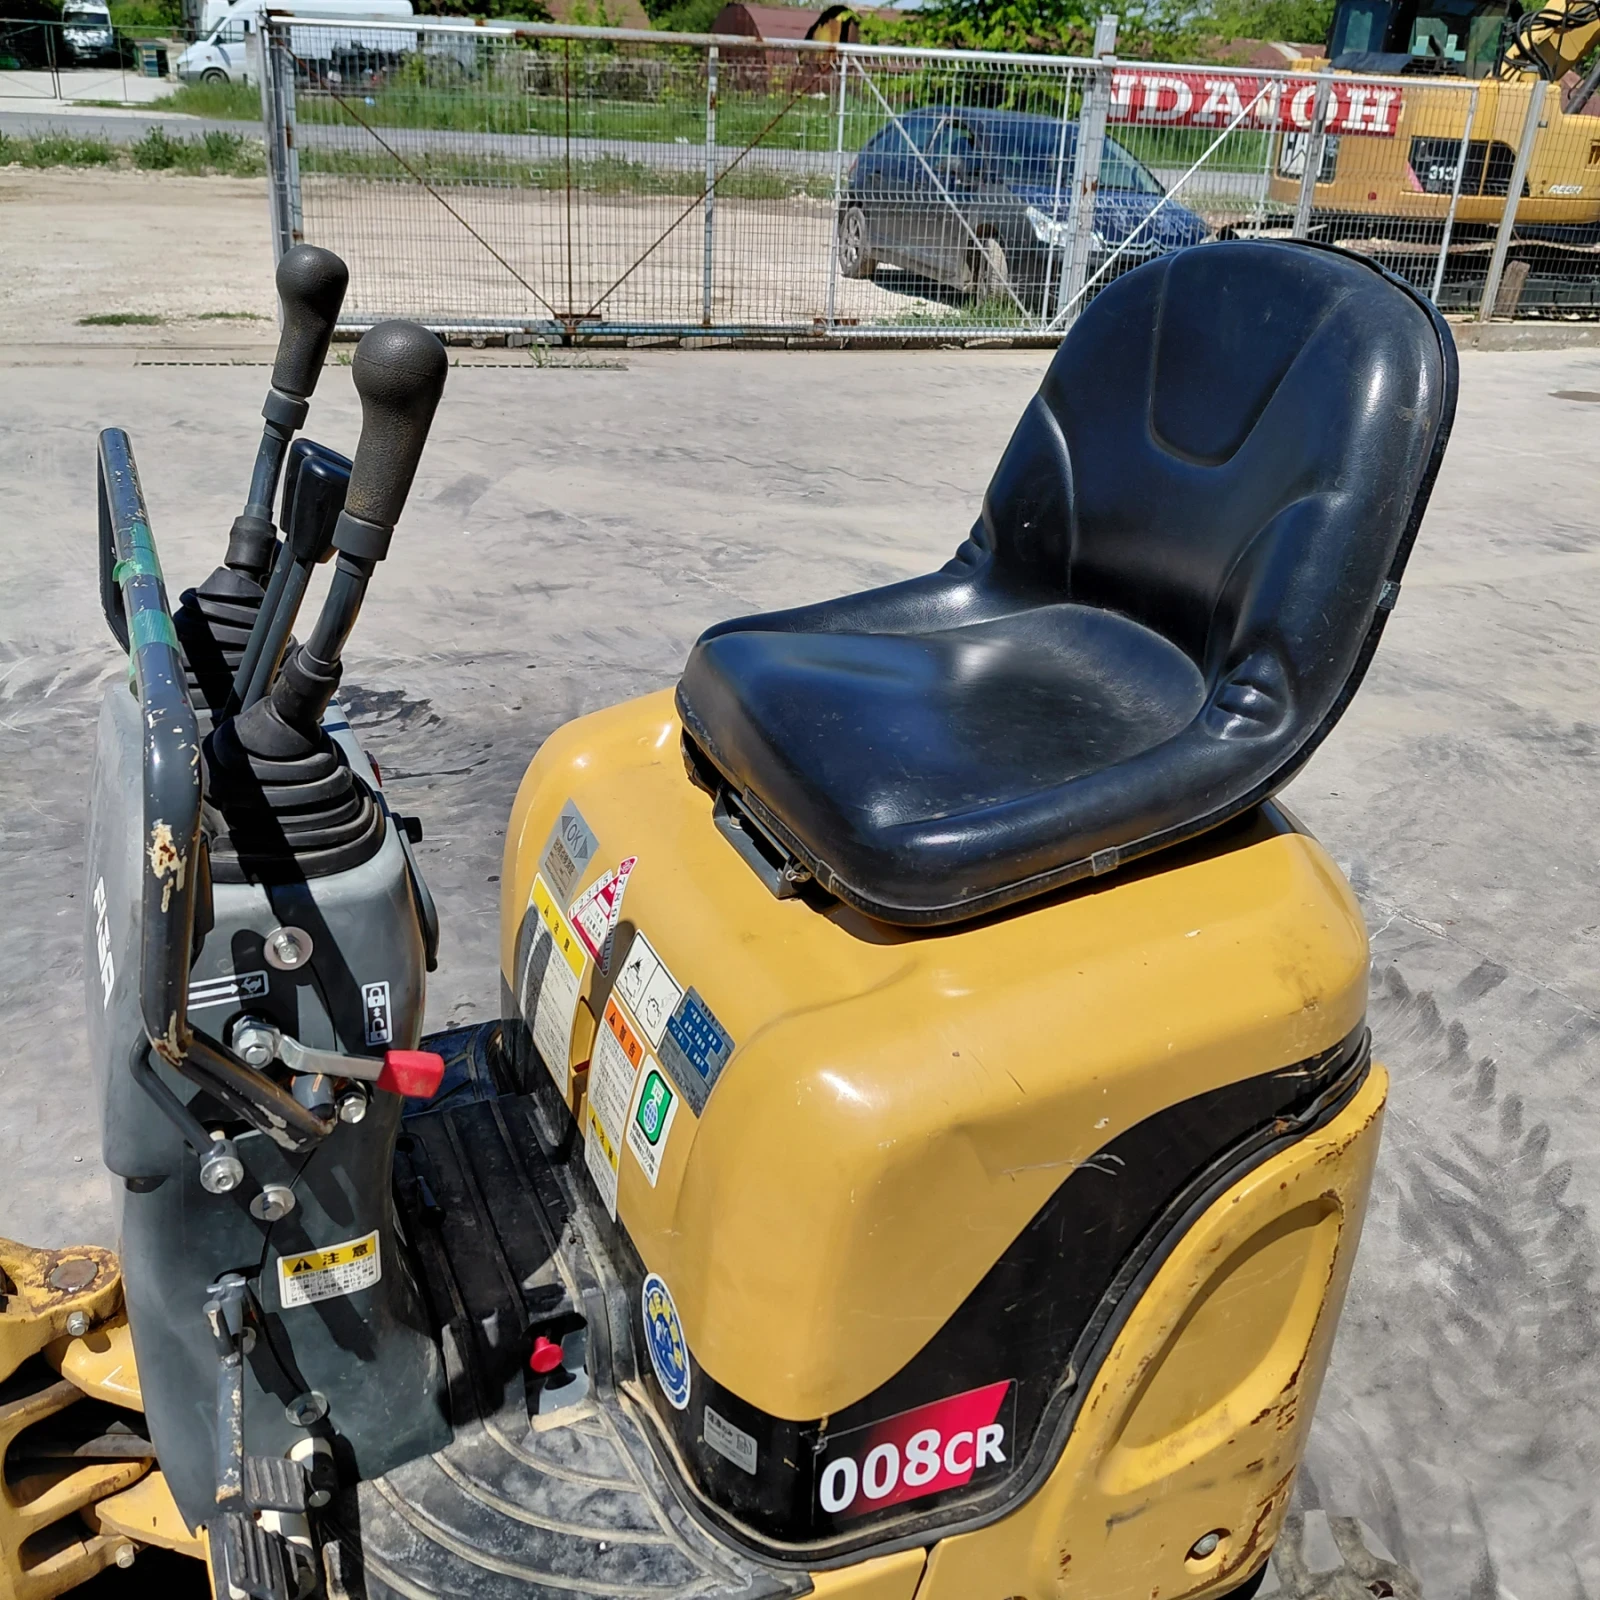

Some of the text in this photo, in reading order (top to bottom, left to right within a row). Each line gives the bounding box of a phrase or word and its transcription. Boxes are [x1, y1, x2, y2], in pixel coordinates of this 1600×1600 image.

[566, 823, 584, 852] OK
[322, 1243, 369, 1267] 注意
[819, 1423, 1007, 1514] 008CR
